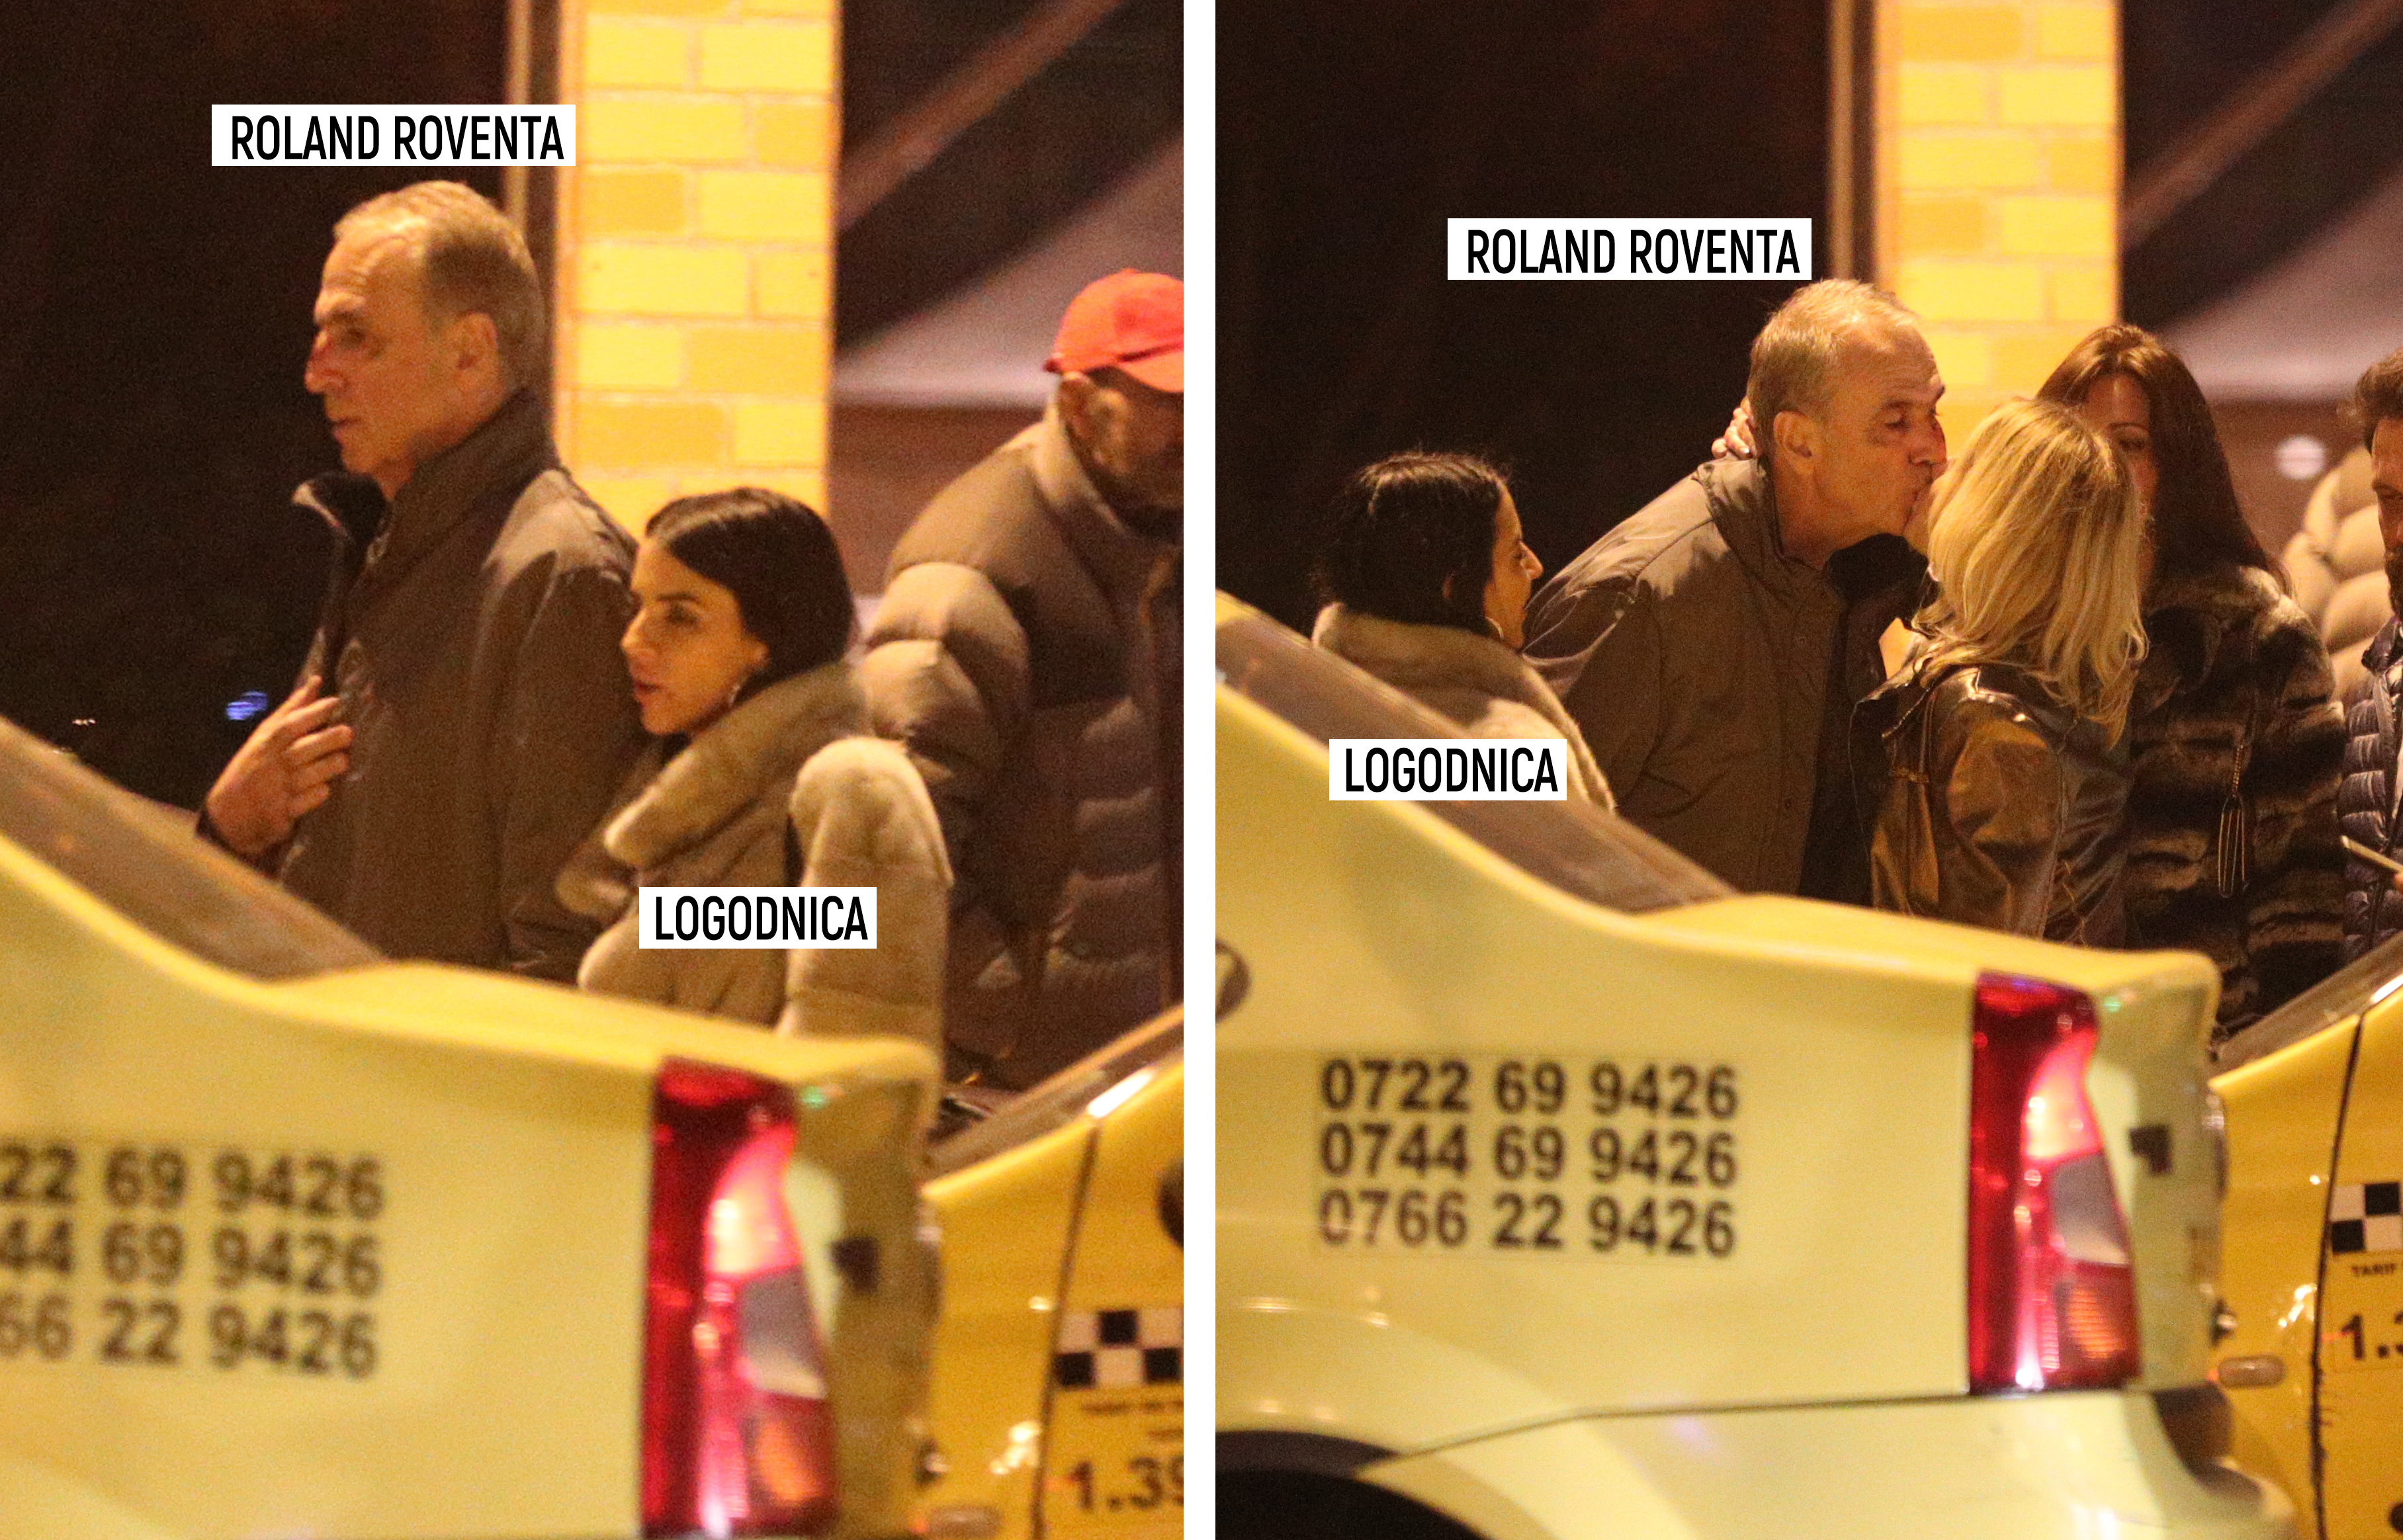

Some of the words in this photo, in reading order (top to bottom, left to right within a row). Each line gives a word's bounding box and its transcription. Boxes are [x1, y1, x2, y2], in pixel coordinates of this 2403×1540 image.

[1320, 1058, 1472, 1114] 0722
[1493, 1060, 1566, 1115] 69
[1589, 1062, 1739, 1119] 9426
[0, 1140, 77, 1207] 22
[103, 1144, 188, 1211] 69
[212, 1146, 386, 1221] 9426
[1319, 1123, 1469, 1178] 0744
[1493, 1126, 1565, 1181] 69
[1589, 1127, 1737, 1187] 9426
[0, 1217, 74, 1275] 44
[101, 1221, 186, 1286] 69
[209, 1225, 382, 1298] 9426
[1319, 1189, 1469, 1246] 0766
[1491, 1193, 1565, 1249] 22
[1587, 1195, 1736, 1258] 9426
[0, 1292, 72, 1361] 66
[100, 1296, 182, 1366] 22
[208, 1302, 378, 1380] 9426
[2340, 1311, 2403, 1361] 1.
